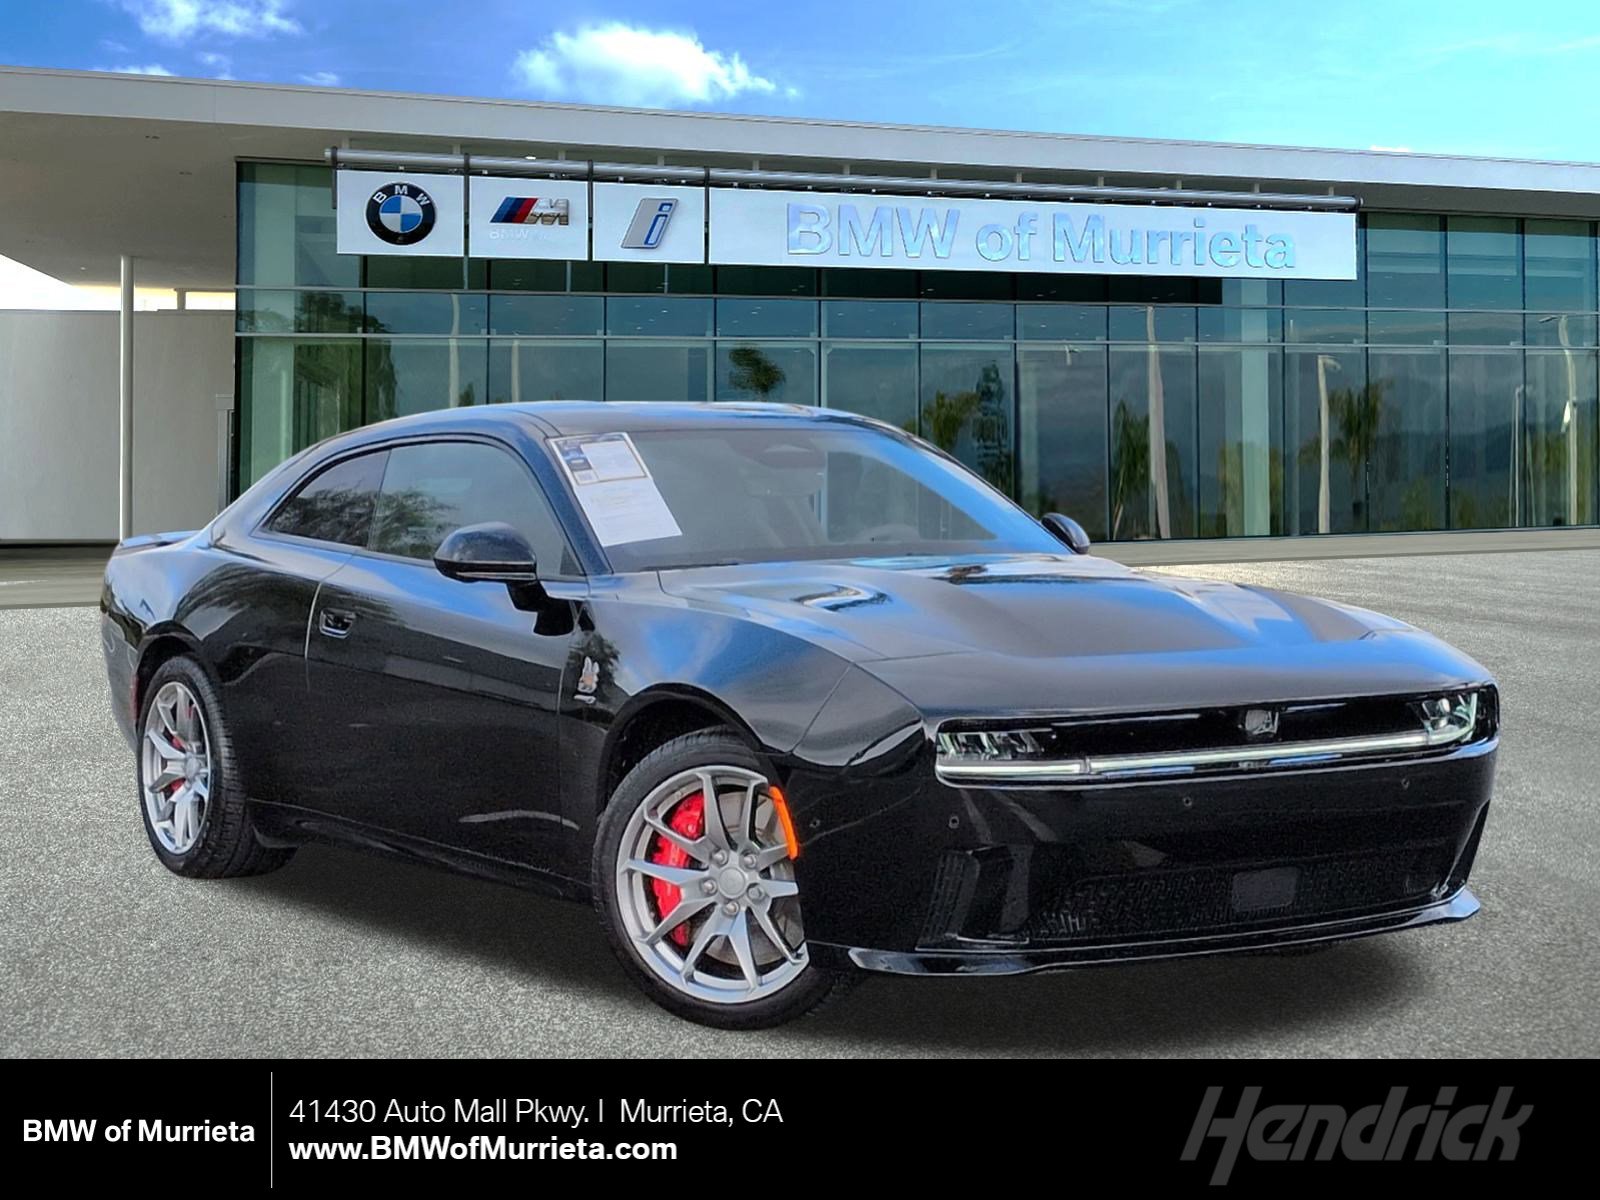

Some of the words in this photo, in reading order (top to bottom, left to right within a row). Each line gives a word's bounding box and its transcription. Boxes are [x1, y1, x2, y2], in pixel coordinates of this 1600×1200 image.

[371, 182, 432, 206] BMW
[786, 202, 960, 259] BMW
[975, 212, 1039, 262] of
[1052, 212, 1296, 269] Murrieta
